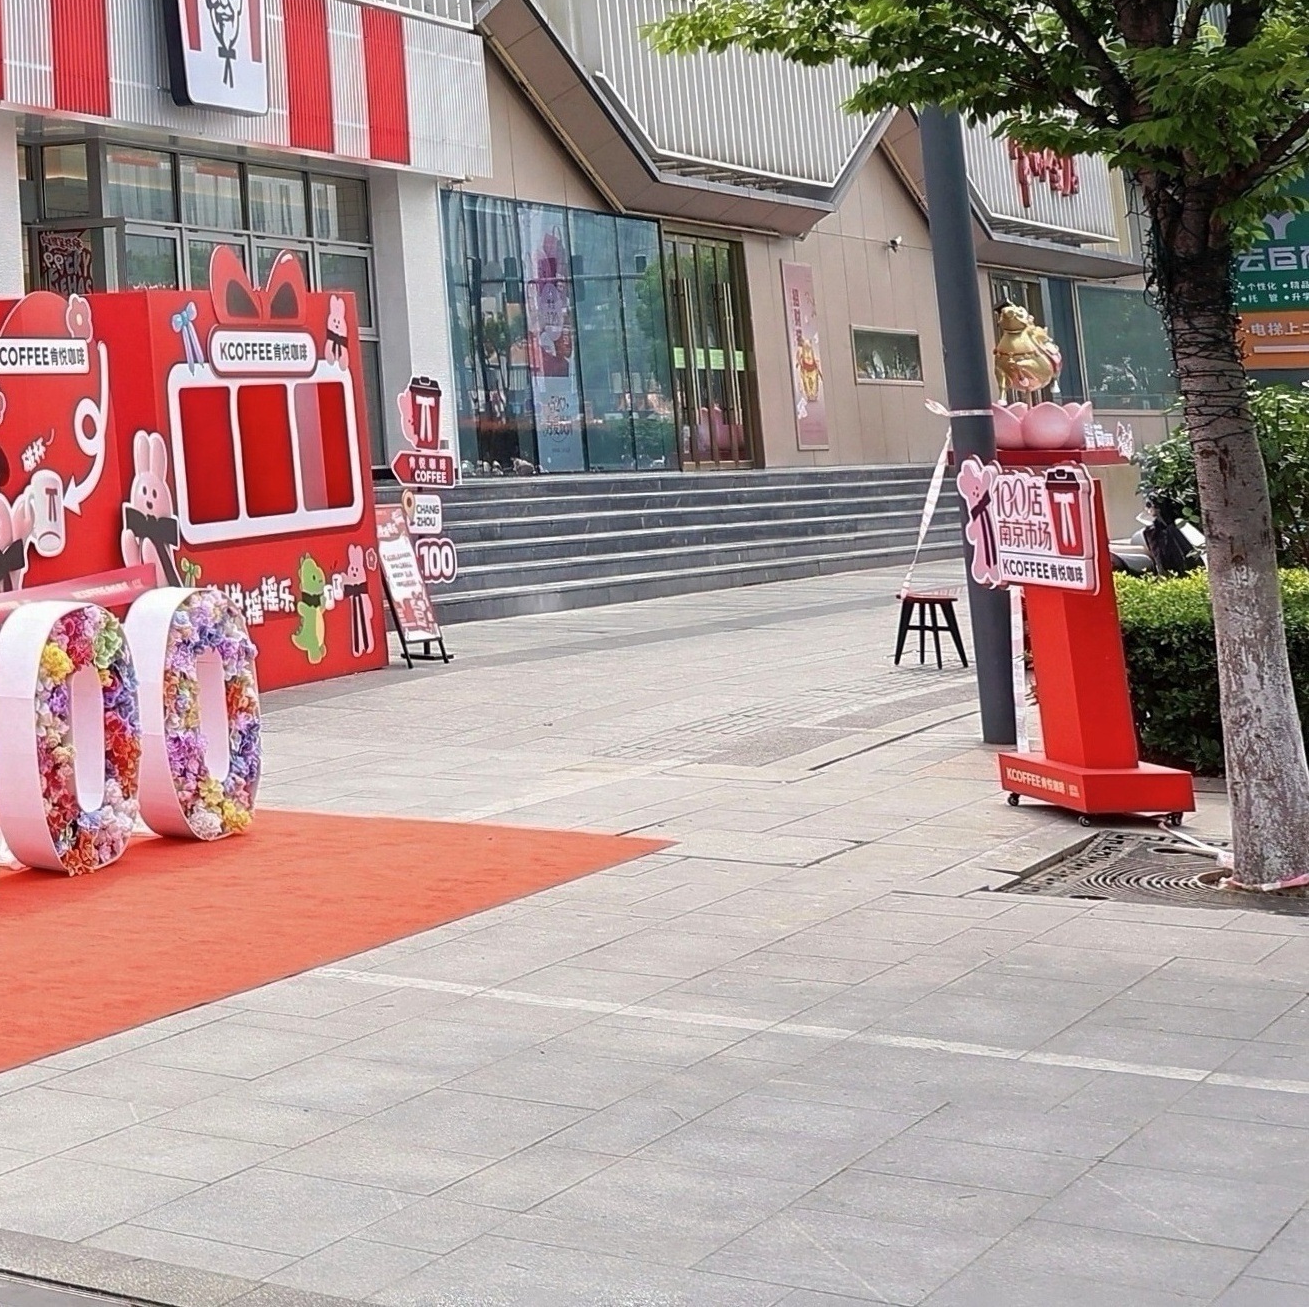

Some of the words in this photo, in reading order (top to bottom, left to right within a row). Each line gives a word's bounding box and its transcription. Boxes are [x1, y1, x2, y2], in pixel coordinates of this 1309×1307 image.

[1238, 245, 1309, 272] 云巨
[416, 504, 440, 514] CHANG
[993, 478, 1046, 519] 100店
[416, 517, 436, 527] ZHOU
[997, 519, 1052, 551] 南京市场
[420, 546, 454, 578] 100
